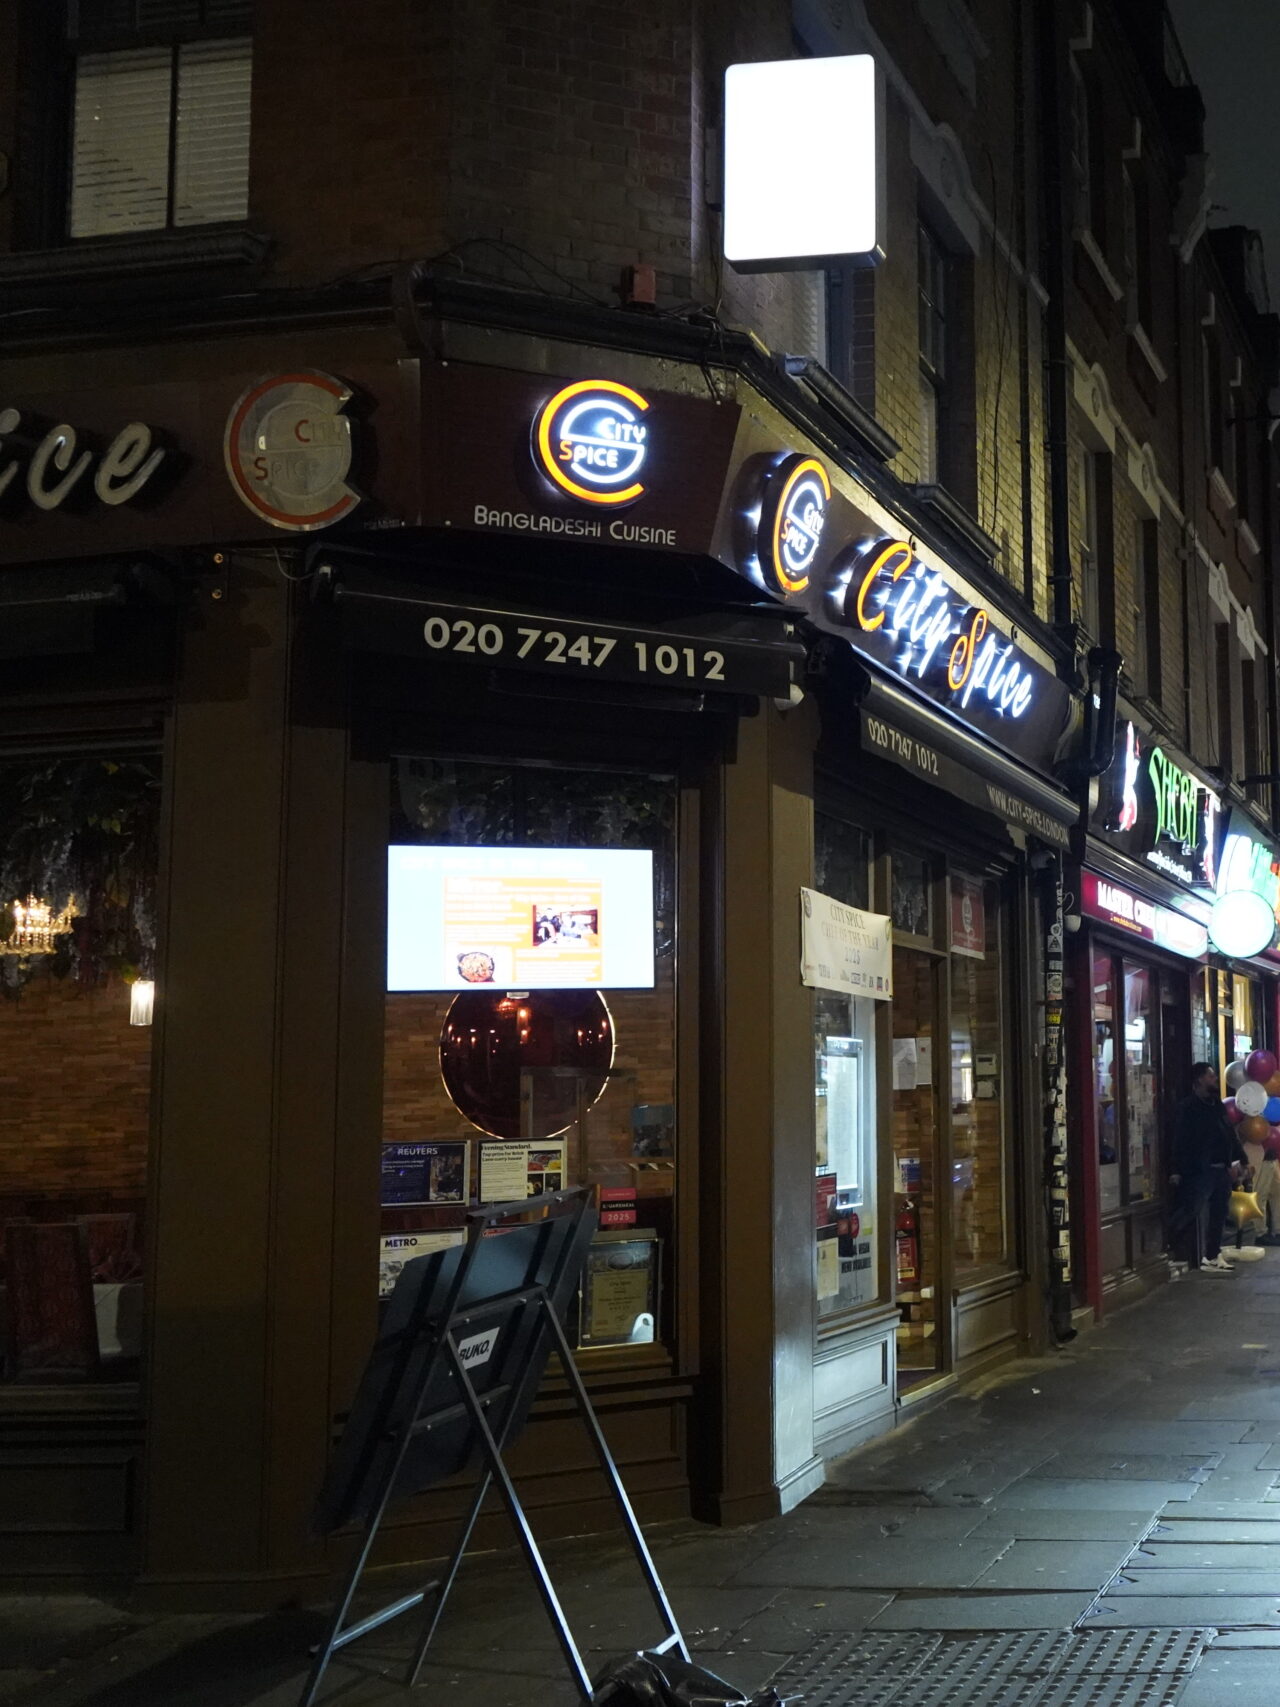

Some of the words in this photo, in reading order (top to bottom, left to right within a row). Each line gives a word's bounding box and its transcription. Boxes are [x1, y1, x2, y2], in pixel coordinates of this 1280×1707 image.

[599, 416, 647, 442] CITY
[558, 439, 618, 468] SPICE
[474, 504, 602, 538] BANGLADESHI
[609, 519, 677, 546] CUISINE
[856, 538, 953, 678] City
[947, 607, 1034, 719] Spice
[423, 616, 503, 656] 020
[516, 626, 618, 668] 7247
[634, 641, 726, 682] 1012
[867, 717, 889, 750] 020
[890, 730, 914, 768] 7247
[915, 742, 939, 777] 1012
[1148, 746, 1198, 850] SHEBA
[1097, 880, 1134, 921] MASTER
[830, 903, 844, 924] CITY
[845, 909, 866, 930] SPICE
[847, 929, 861, 946] THE
[397, 1147, 439, 1156] REUTERS
[607, 1213, 630, 1221] 2025
[384, 1238, 418, 1248] METRO
